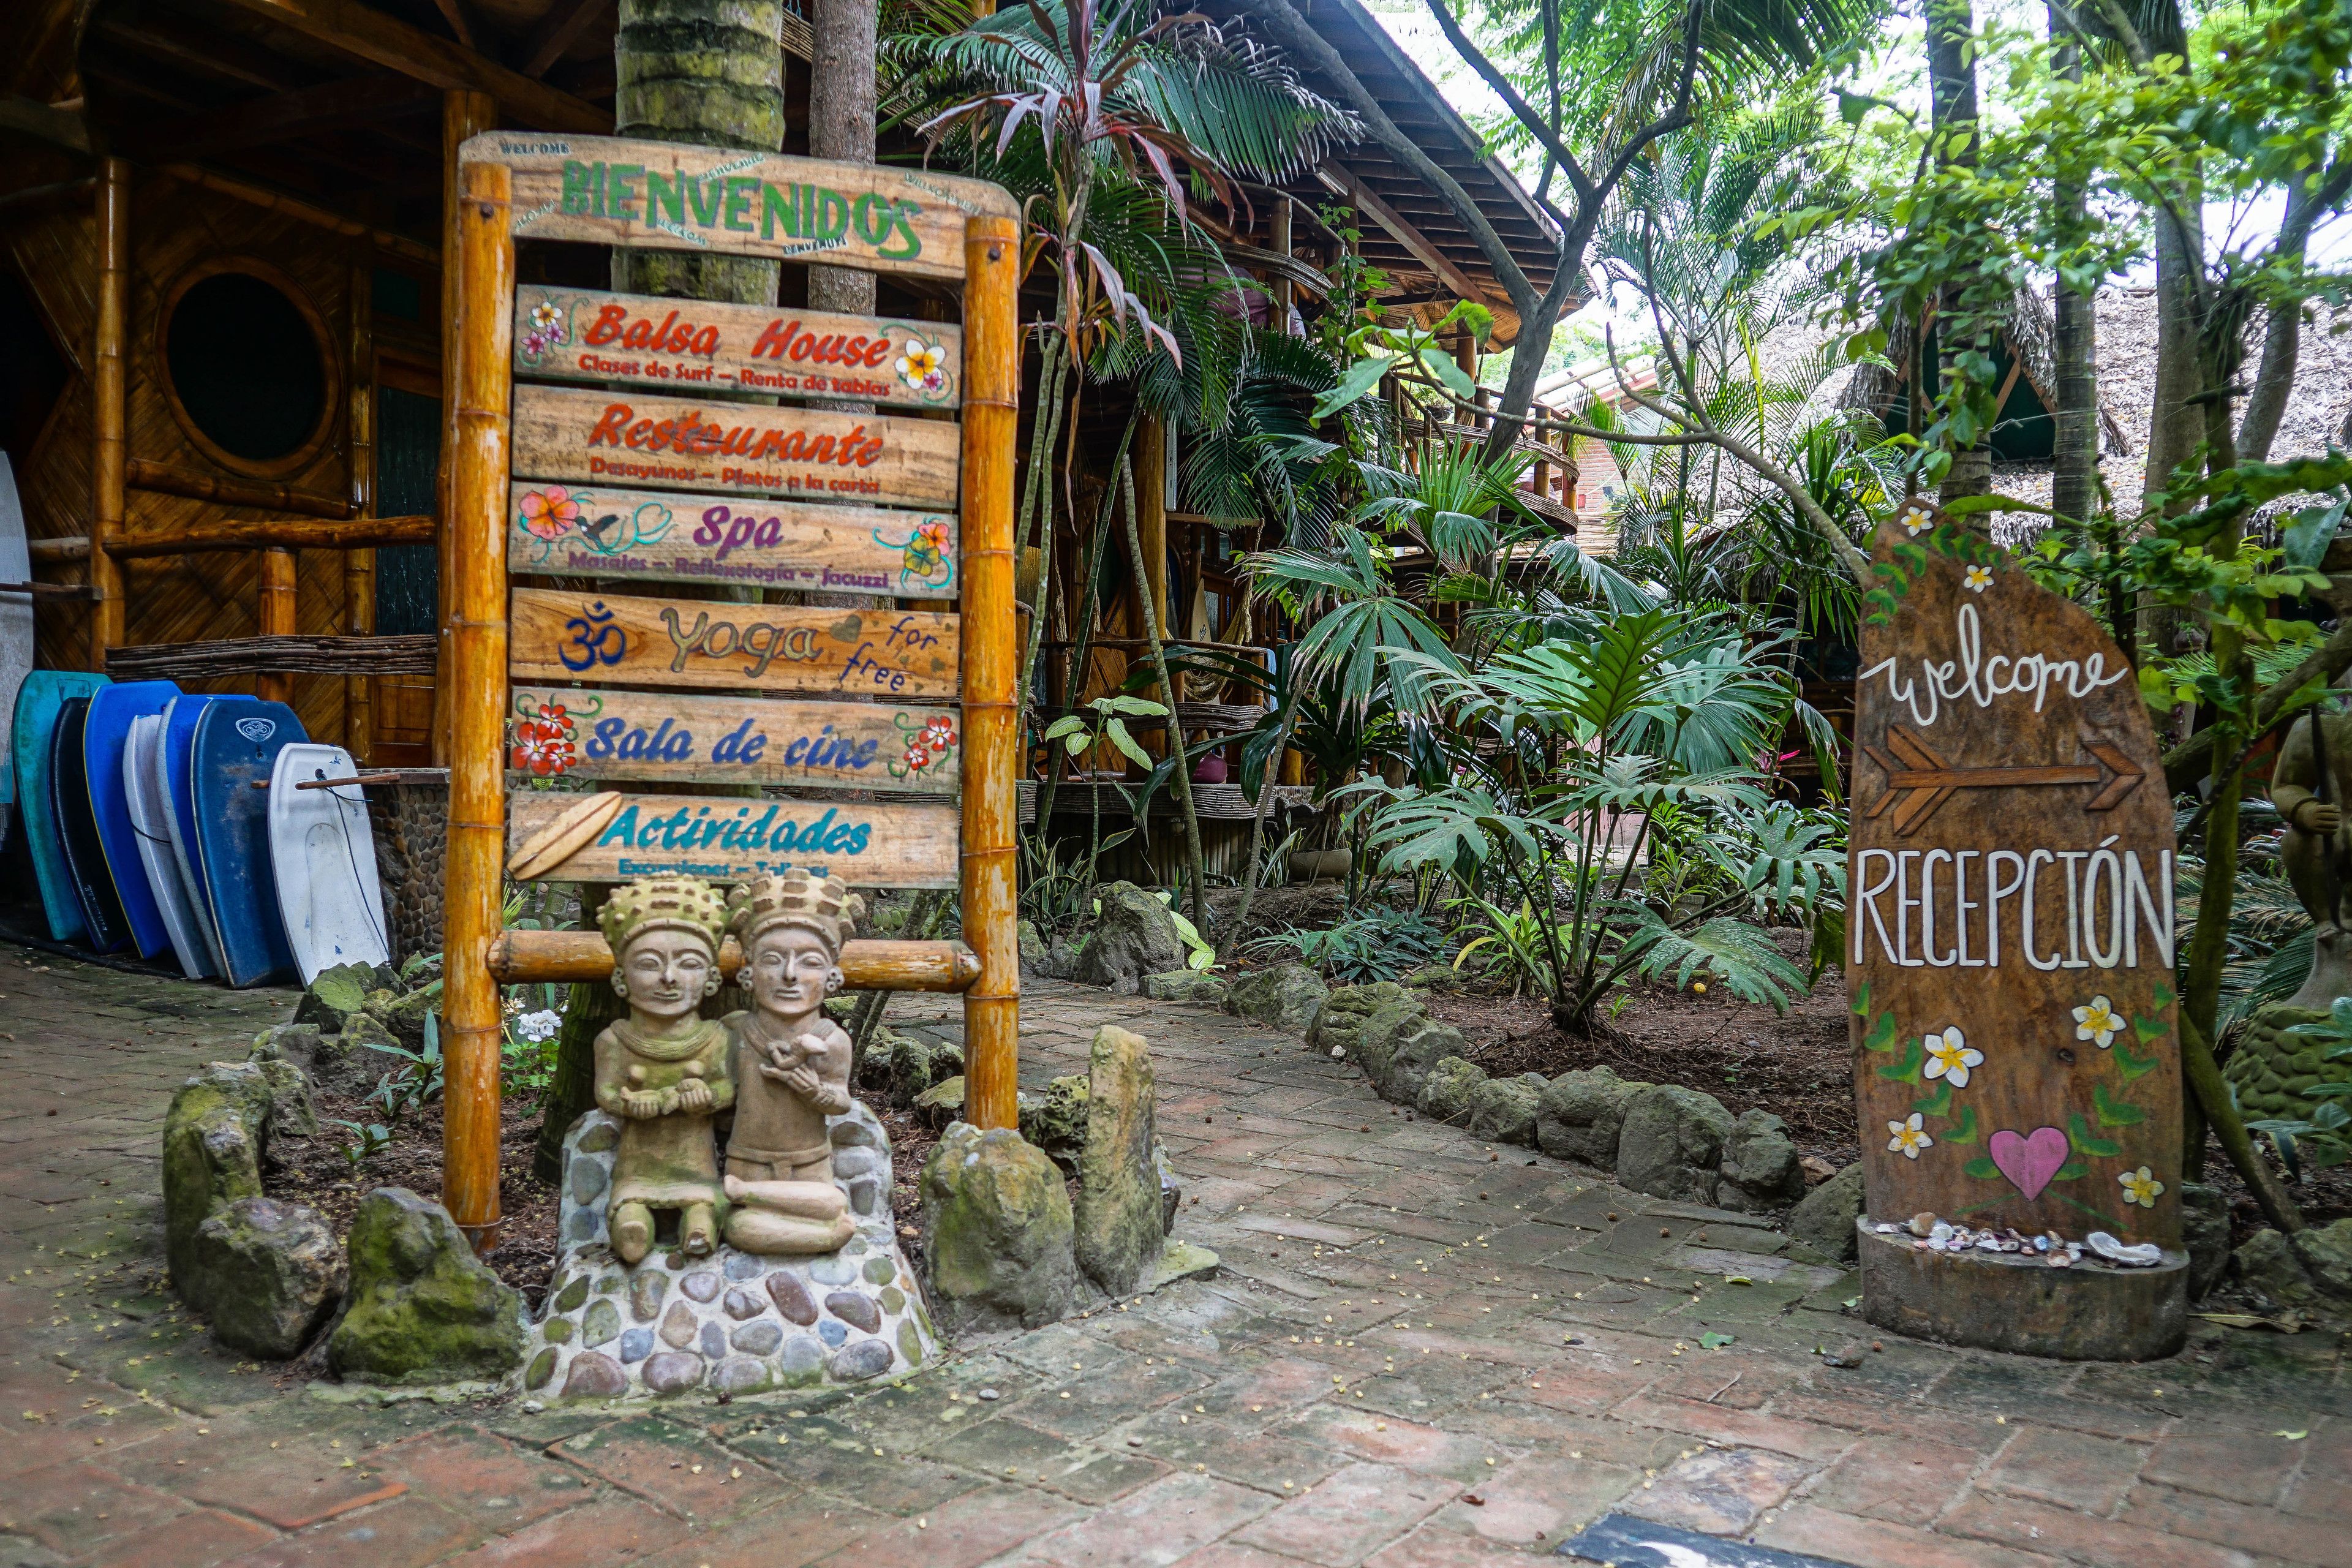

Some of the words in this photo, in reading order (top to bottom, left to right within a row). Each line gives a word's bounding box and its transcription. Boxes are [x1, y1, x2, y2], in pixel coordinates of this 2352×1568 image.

[562, 160, 922, 260] BIENVENIDOS
[584, 304, 720, 357] Balsa
[752, 318, 891, 368] House
[578, 354, 639, 375] Clases
[644, 360, 669, 379] de
[675, 363, 714, 382] Surf
[740, 369, 797, 389] Renta
[803, 375, 827, 392] de
[831, 377, 891, 397] tablas
[590, 456, 695, 481] Desayunos
[722, 467, 782, 488] Platos
[788, 475, 801, 488] a
[805, 473, 823, 491] la
[829, 478, 880, 494] carta
[693, 505, 786, 560] Spa
[660, 607, 823, 678] Yoga
[886, 615, 939, 653] for
[839, 642, 907, 692] free
[1858, 603, 2129, 726] welcome
[586, 717, 694, 760] Sala
[711, 717, 766, 764] de
[784, 725, 879, 770] cine
[597, 804, 872, 856] Actividades
[1854, 834, 2175, 971] RECEPCIÓN
